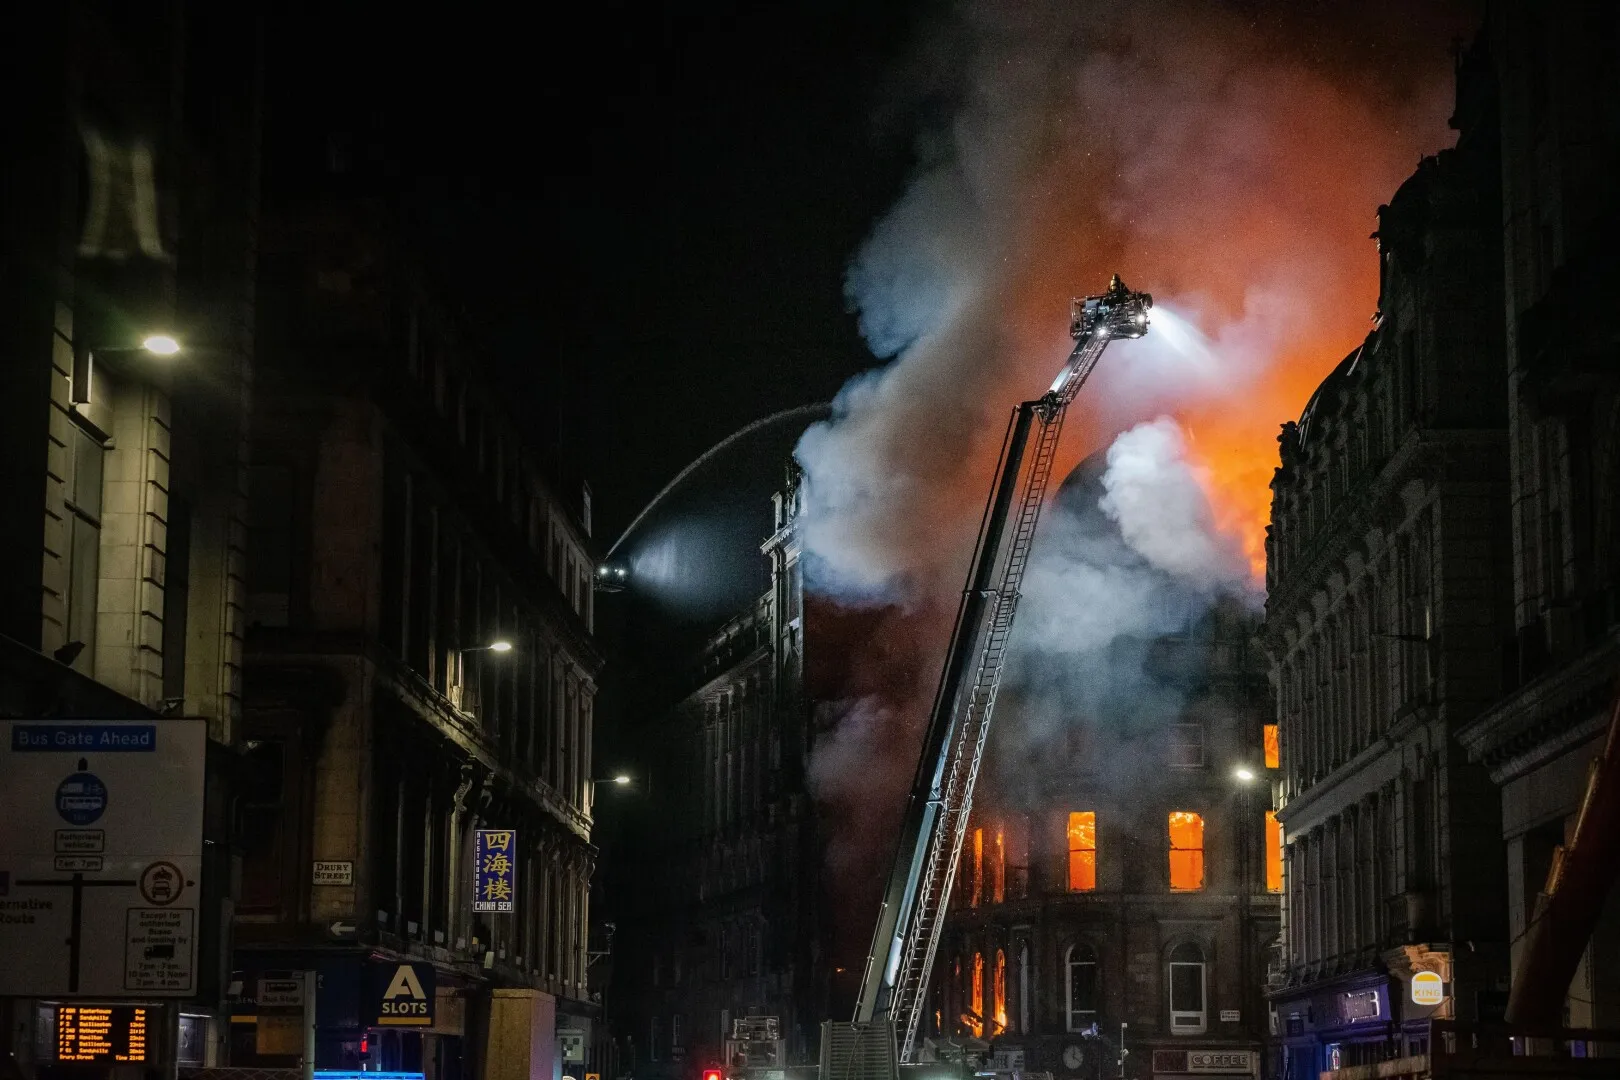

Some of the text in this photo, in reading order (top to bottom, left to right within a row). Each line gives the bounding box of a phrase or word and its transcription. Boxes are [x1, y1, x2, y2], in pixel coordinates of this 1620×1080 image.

[19, 731, 150, 745] Bus Gate Ahead
[316, 862, 349, 871] DRURY
[482, 832, 512, 901] 四海楼
[314, 871, 350, 879] STREET
[0, 898, 53, 910] ernative
[475, 901, 512, 911] CHINA SEA
[0, 912, 35, 924] Route
[141, 911, 167, 920] Except
[383, 964, 427, 999] A
[1414, 989, 1441, 997] KING
[382, 1002, 428, 1014] SLOTS
[1192, 1054, 1249, 1065] COFFEE
